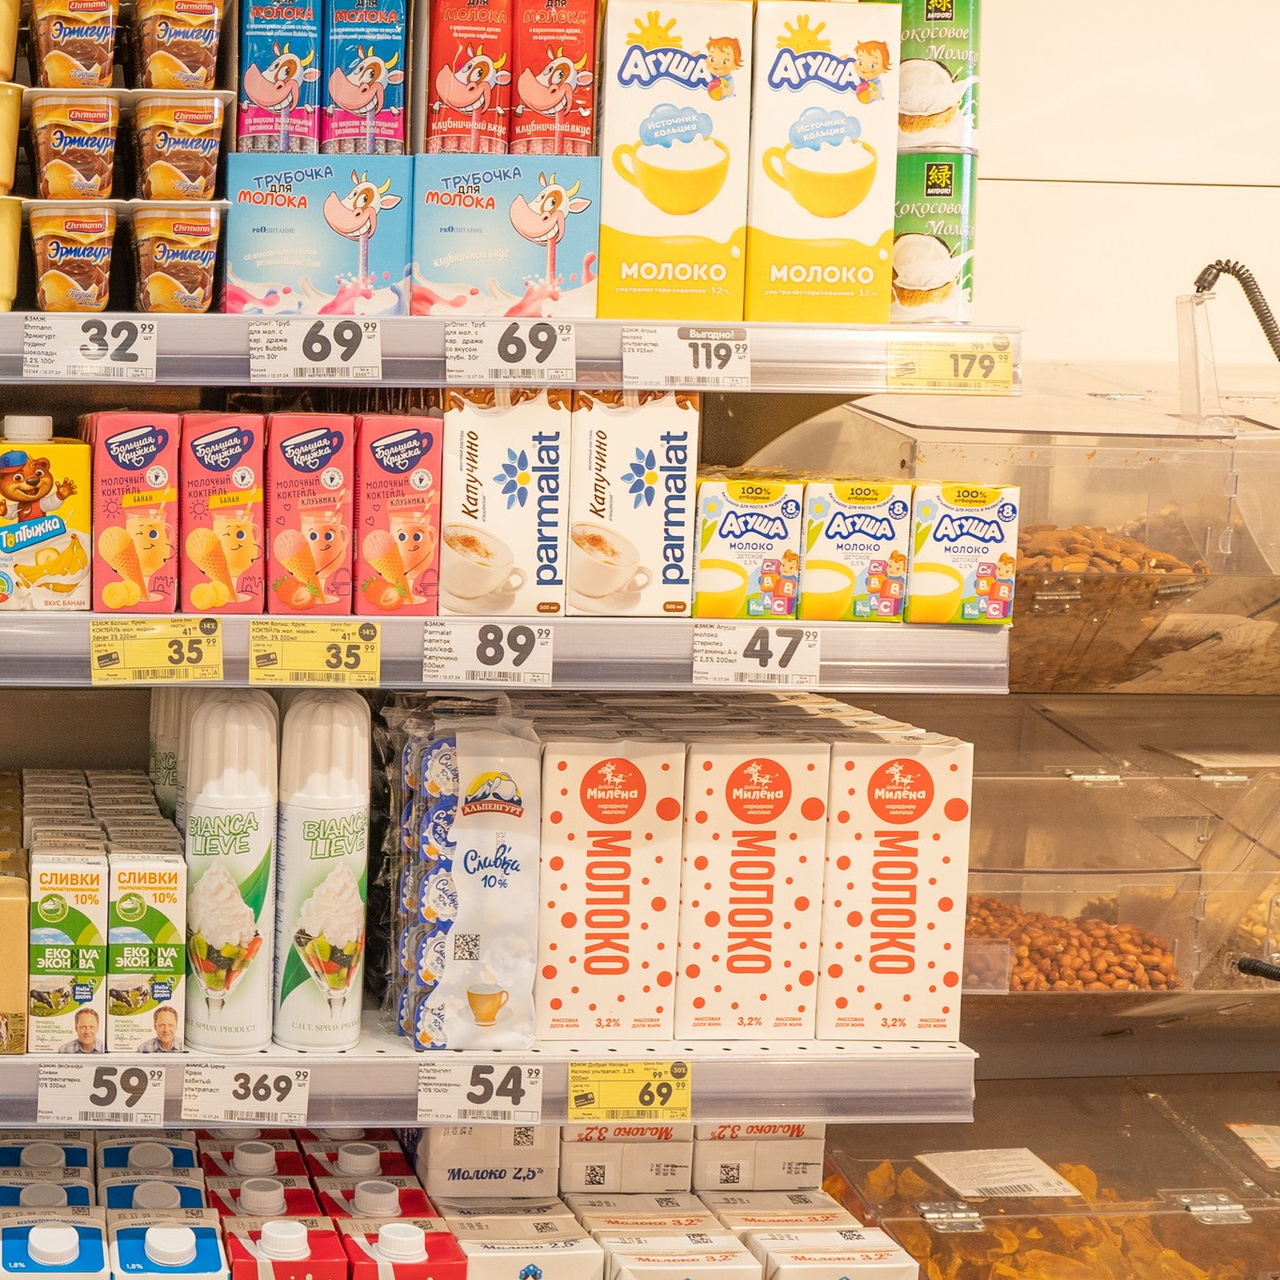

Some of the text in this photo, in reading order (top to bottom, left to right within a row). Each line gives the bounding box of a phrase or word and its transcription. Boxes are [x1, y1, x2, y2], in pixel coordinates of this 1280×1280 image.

[70, 1, 107, 11] Ehrmann
[432, 121, 507, 136] клубничный вкус
[648, 114, 698, 130] Источник
[254, 166, 333, 188] ТРУБОЧКА
[238, 191, 308, 209] МОЛОКА
[621, 262, 727, 281] МОЛОКО
[302, 320, 362, 364] 69
[689, 330, 735, 340] Выгодно!
[688, 342, 732, 369] 119
[949, 354, 995, 378] 179
[462, 430, 480, 520] Капучино
[301, 496, 336, 506] КЛУБНИКА
[741, 487, 770, 496] 100%
[532, 430, 562, 586] parmalat
[168, 640, 204, 665] 35
[476, 624, 535, 666] 89
[743, 627, 804, 668] 47
[463, 804, 522, 816] АЛЬПЕНГУРТ
[482, 875, 508, 888] 10%
[584, 830, 631, 975] МОЛОКО
[90, 1066, 148, 1107] 59
[232, 1074, 292, 1101] 369
[467, 1066, 525, 1105] 54
[638, 1083, 671, 1105] 69
